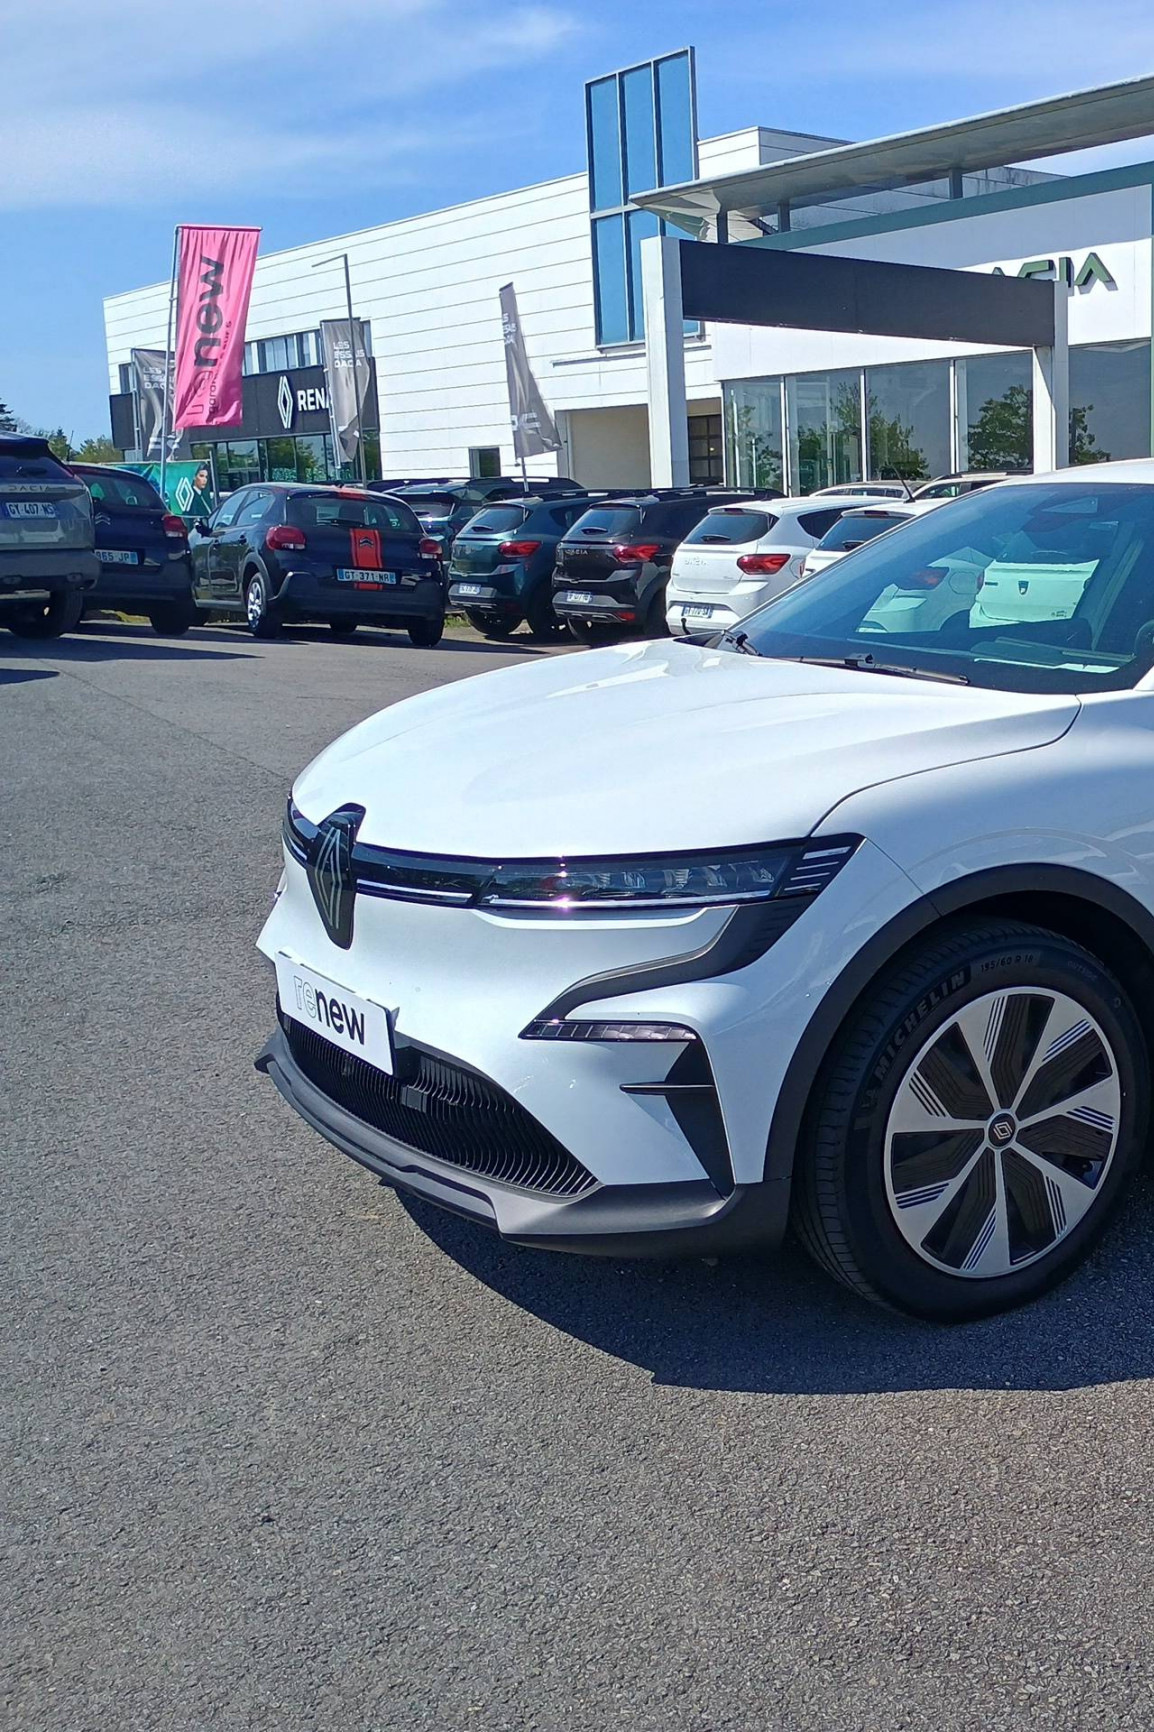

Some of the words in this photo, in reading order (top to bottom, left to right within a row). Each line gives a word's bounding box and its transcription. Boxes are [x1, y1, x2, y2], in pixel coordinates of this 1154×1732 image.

[335, 359, 362, 368] DACA
[294, 975, 365, 1046] renew
[874, 970, 966, 1081] MICHELIN
